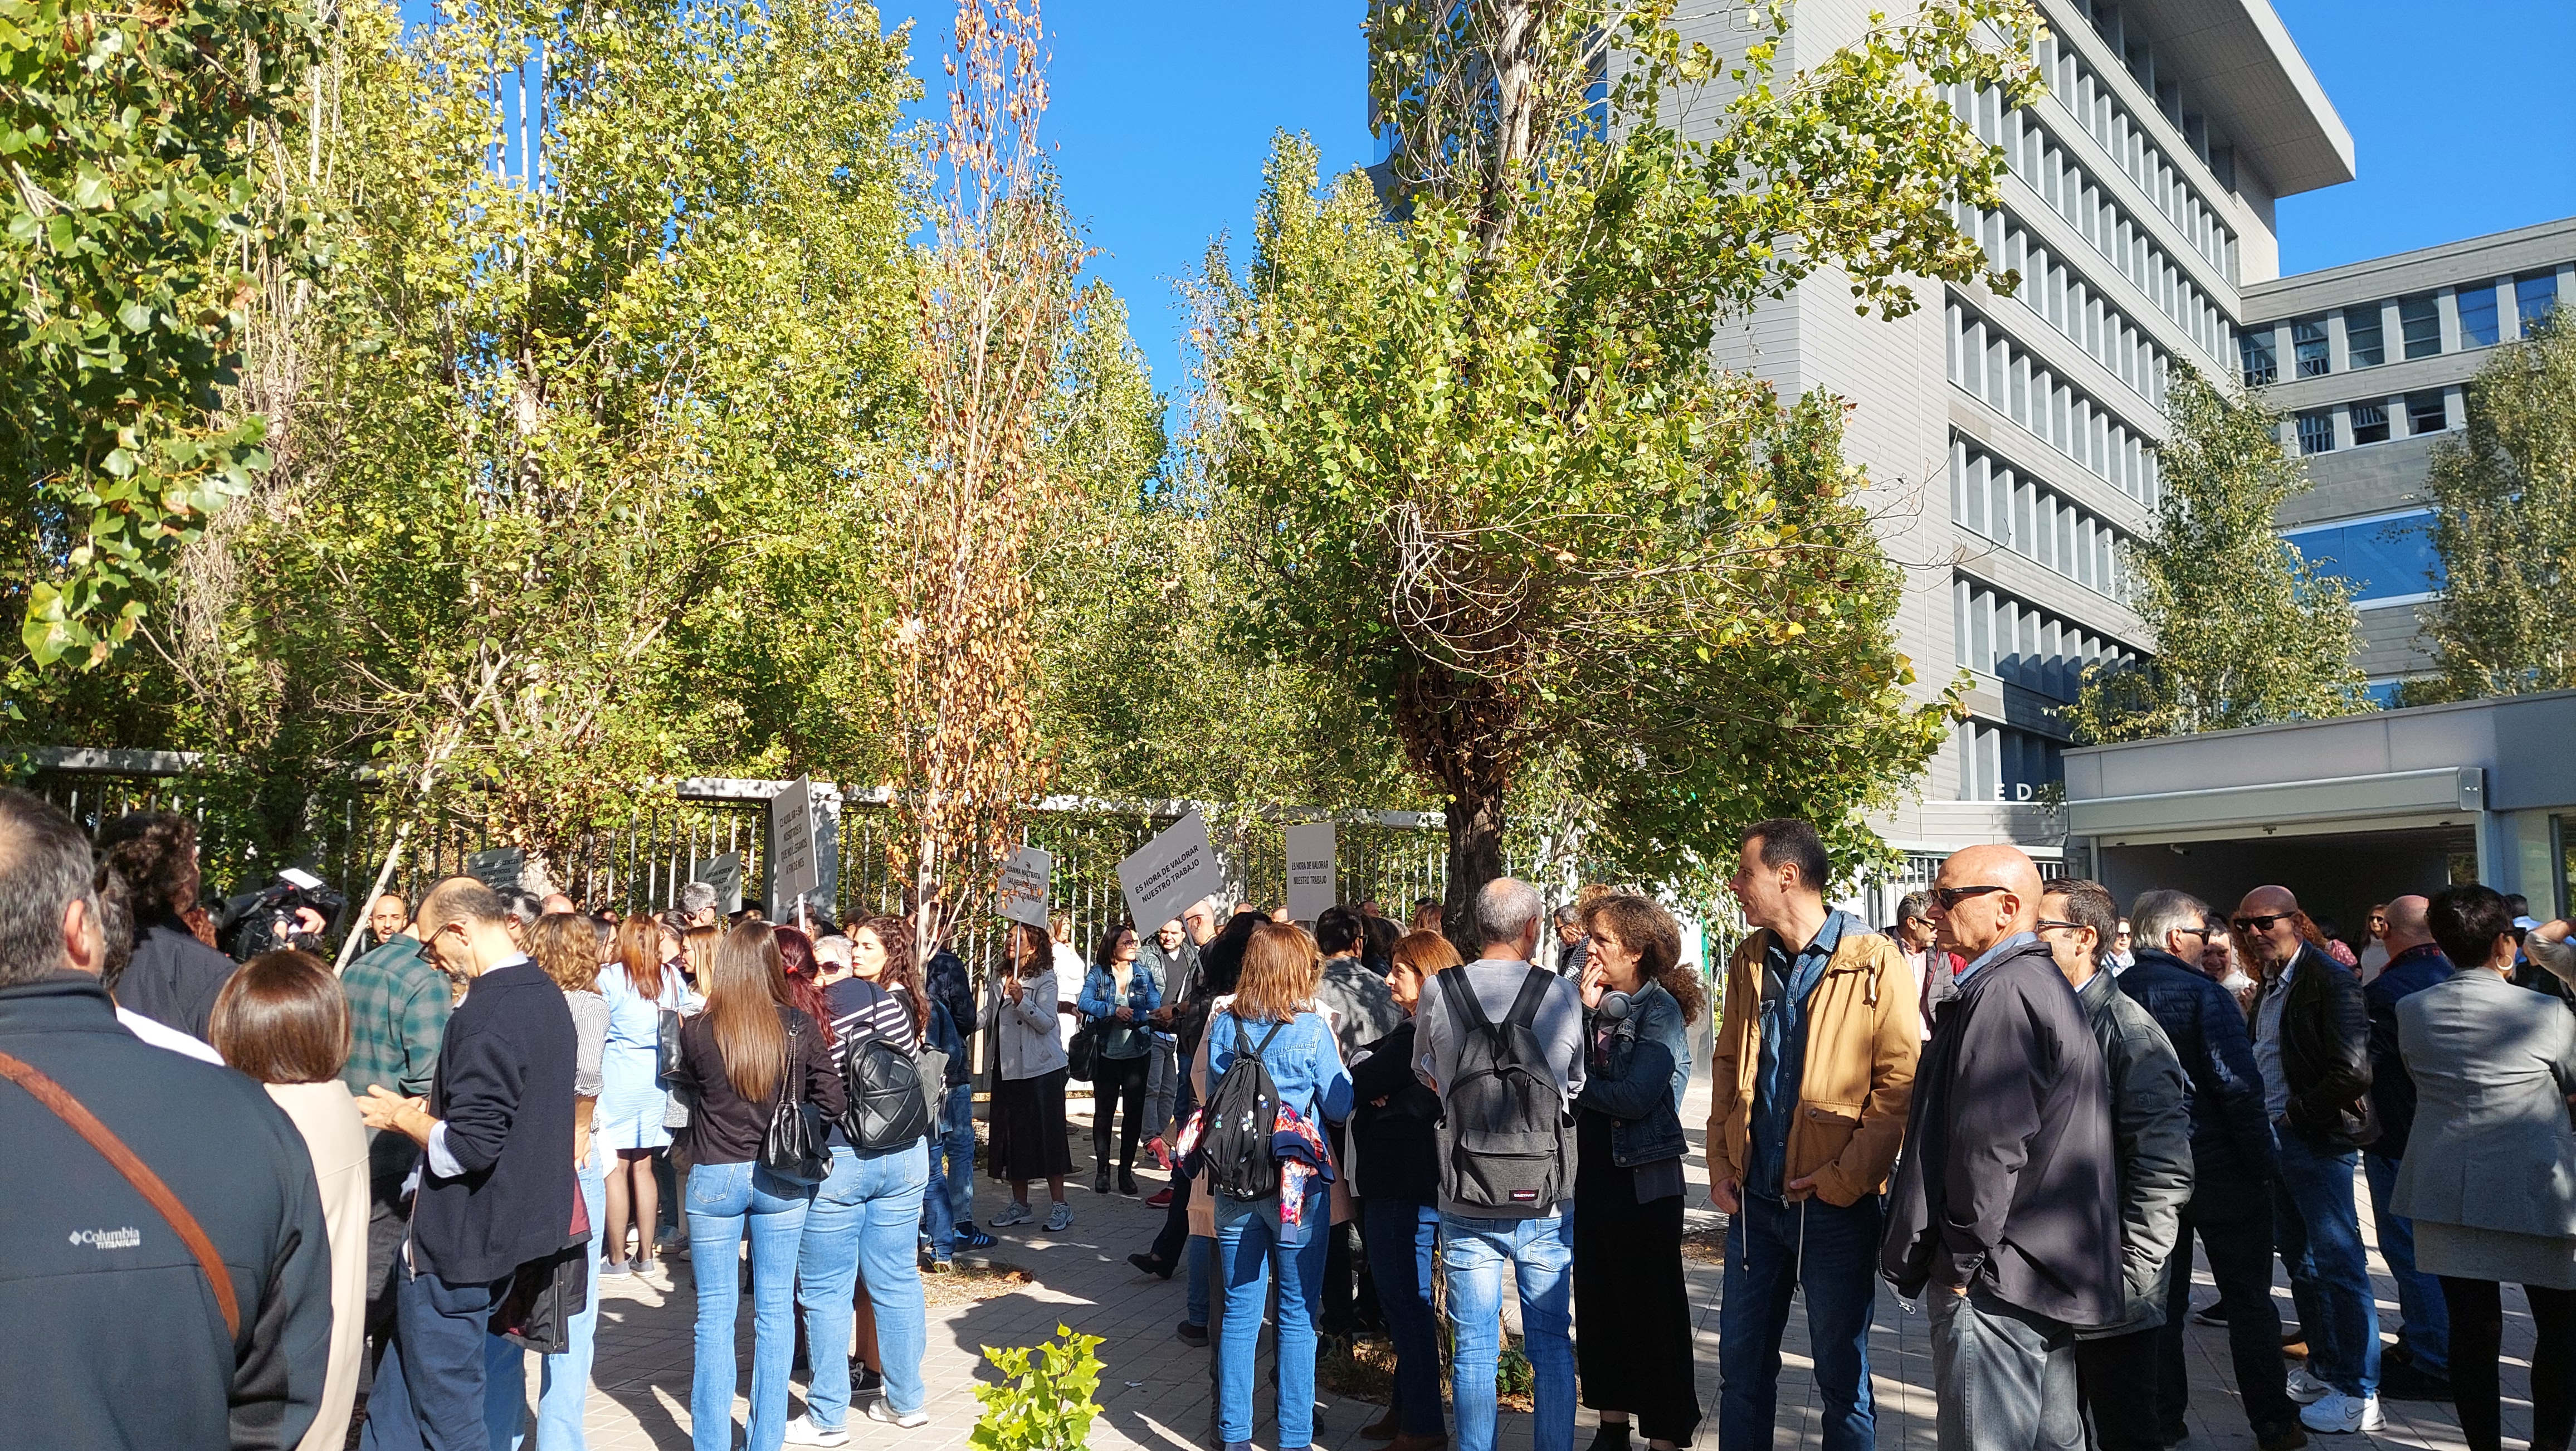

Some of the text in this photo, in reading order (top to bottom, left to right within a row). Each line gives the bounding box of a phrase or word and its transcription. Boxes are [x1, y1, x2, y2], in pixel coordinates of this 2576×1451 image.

[1993, 783, 2033, 801] ED
[1135, 845, 1199, 894] ES HORA DE VALORAR
[1291, 860, 1329, 870] ES HORA DE VALORAR
[1141, 859, 1199, 904] NUESTRO TRABAJO
[1293, 875, 1327, 884] NUESTRO TRABAJO
[82, 1226, 140, 1243] Columbia
[96, 1238, 140, 1250] TITANIUM
